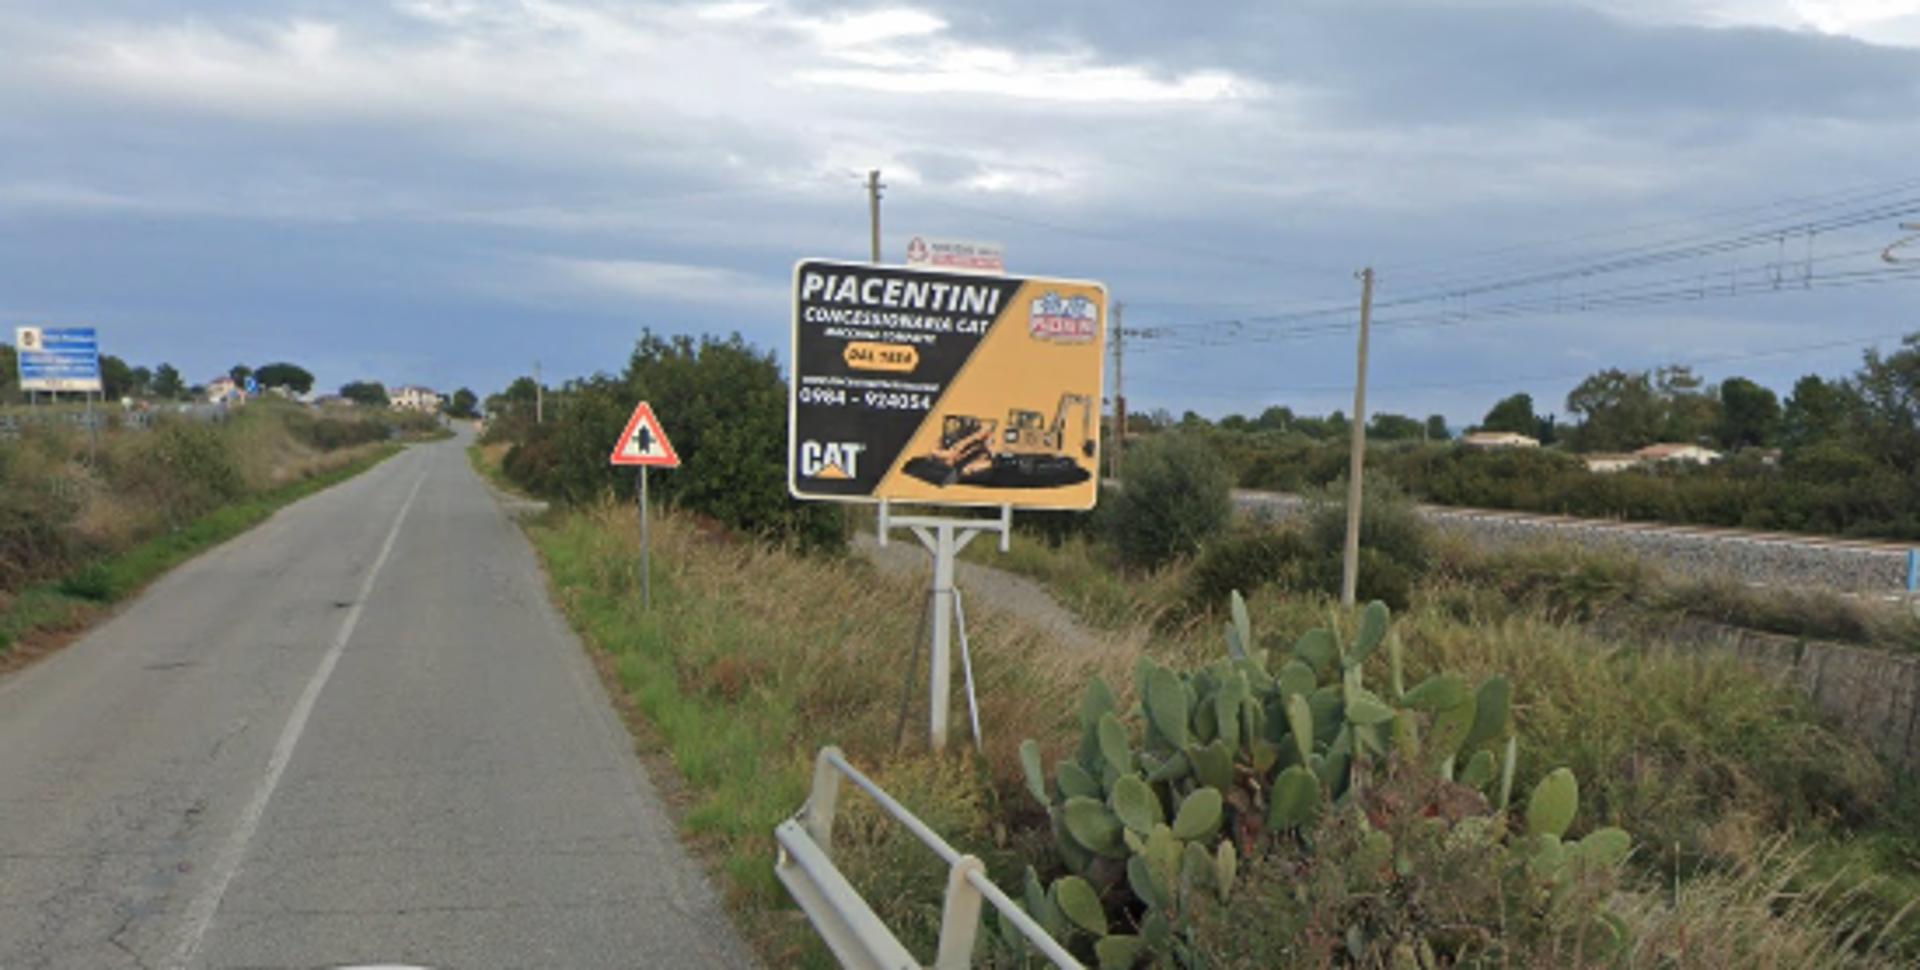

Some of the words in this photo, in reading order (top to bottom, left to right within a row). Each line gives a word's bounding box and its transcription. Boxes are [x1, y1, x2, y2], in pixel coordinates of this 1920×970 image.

[802, 272, 1000, 315] PIACENTINI
[805, 306, 953, 333] CONCESSIONARIA
[956, 318, 989, 335] CAT
[799, 387, 846, 406] 0984
[802, 439, 860, 479] CAT
